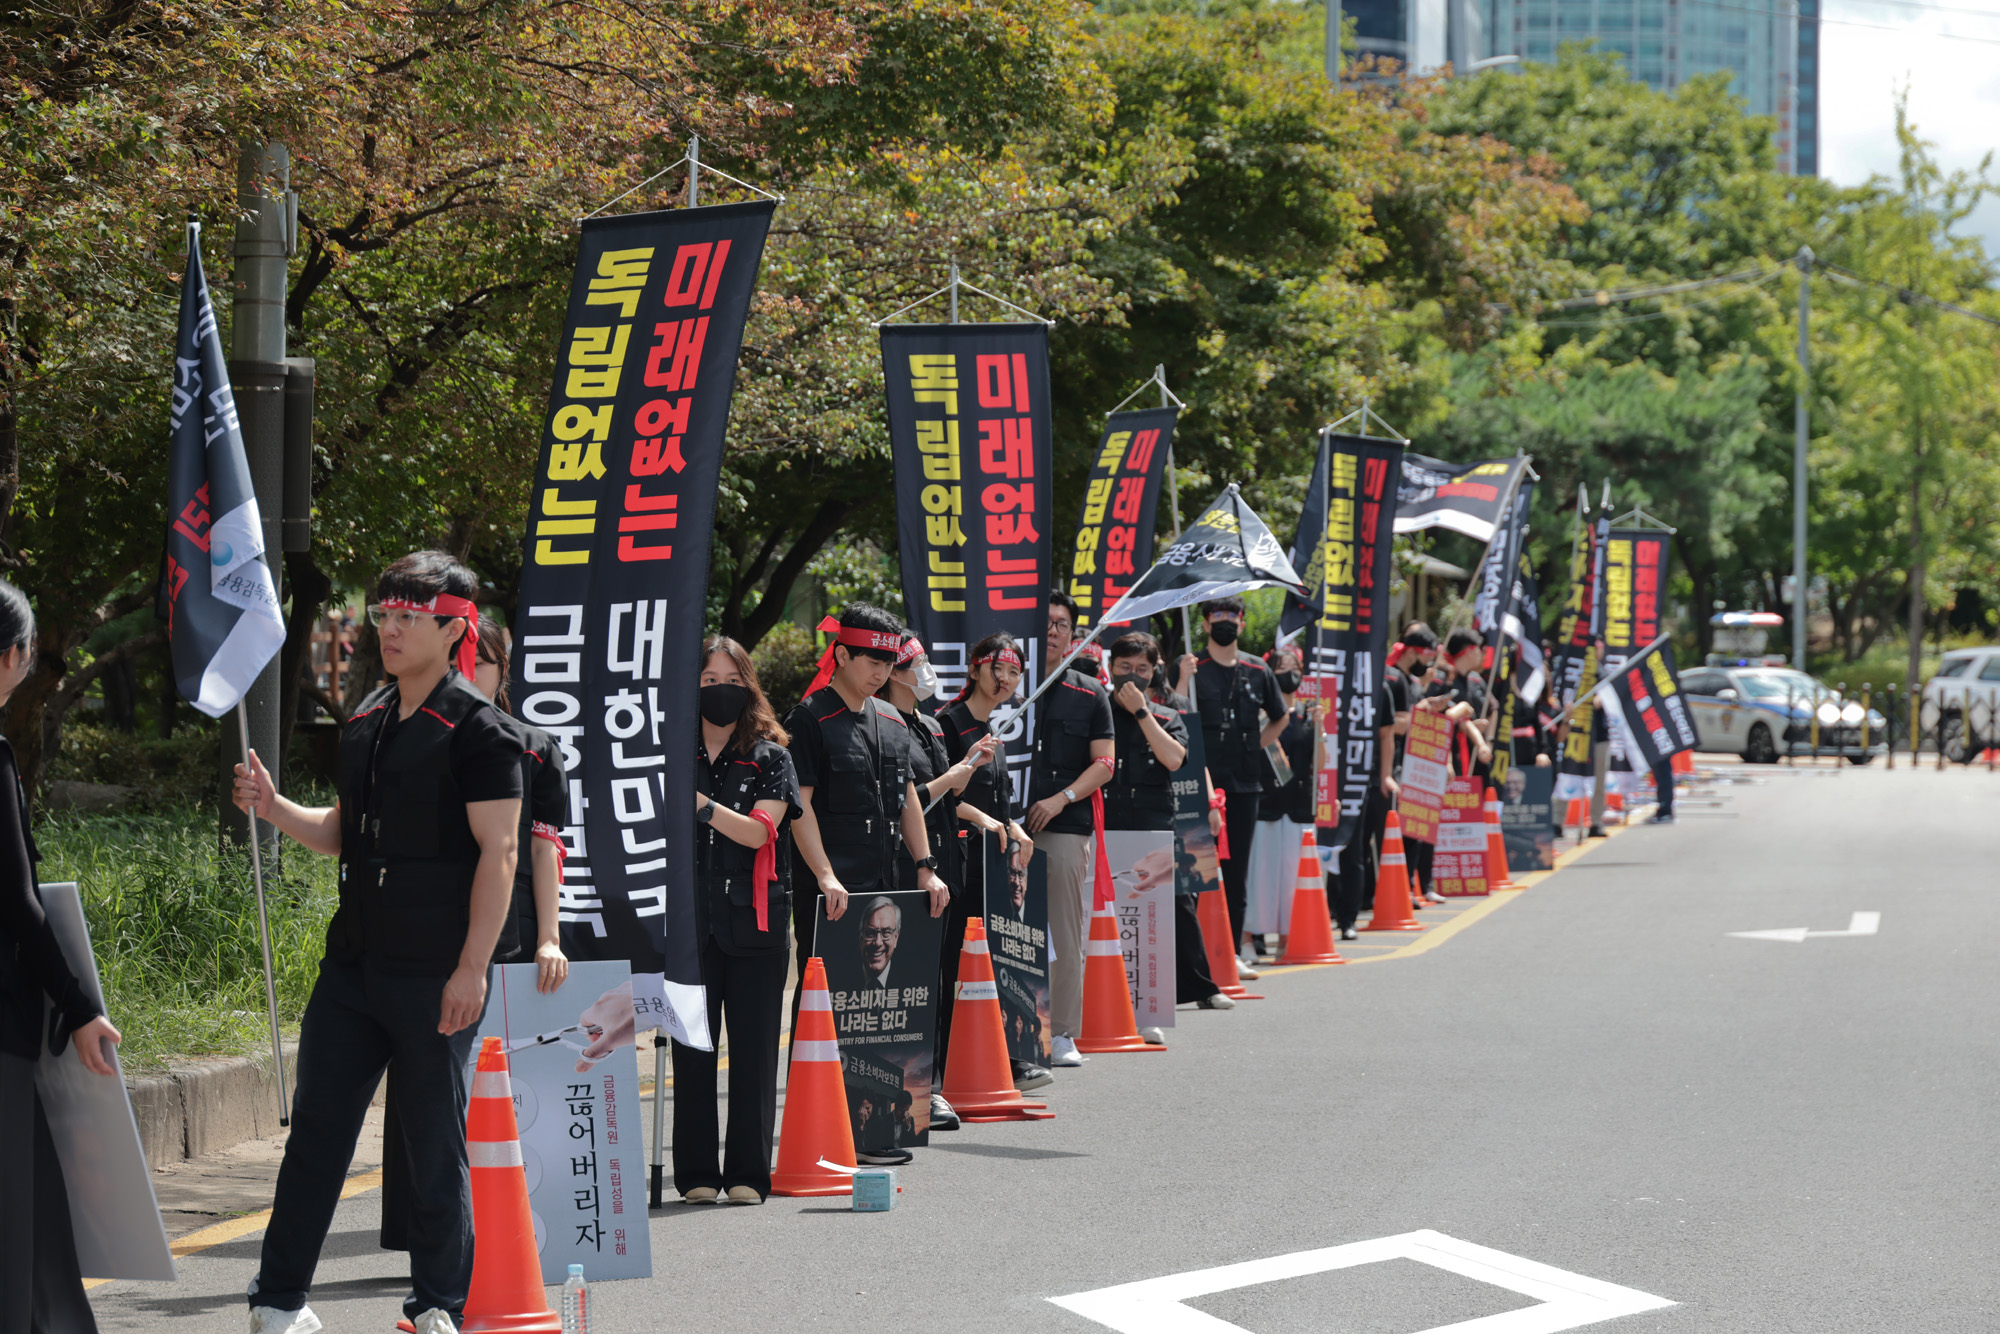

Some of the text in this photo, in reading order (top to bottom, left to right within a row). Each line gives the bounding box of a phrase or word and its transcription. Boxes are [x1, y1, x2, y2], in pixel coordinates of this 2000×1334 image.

[535, 247, 655, 566] 독립없는
[617, 239, 732, 563] 미래없는
[909, 354, 968, 612] 독립없는
[976, 353, 1040, 611] 미래없는
[1069, 430, 1133, 626] 독립없는
[1101, 428, 1161, 628] 미래없는
[1314, 452, 1358, 631] 독립없는
[871, 633, 895, 649] 금소원
[1171, 779, 1199, 796] 위한
[1340, 650, 1377, 816] 대한민국
[902, 986, 929, 1008] 위한
[990, 913, 1045, 948] 금융소비자를 위한
[1001, 936, 1036, 964] 나라는 없다
[840, 1010, 908, 1033] 나라는 없다
[850, 1056, 900, 1089] 금융소비자보호원
[854, 1036, 866, 1045] FOR
[866, 1034, 893, 1044] FINANCIAL
[893, 1032, 924, 1043] CONSUMERS
[564, 1083, 606, 1253] 끊어버리자
[602, 1075, 627, 1256] 금융감독원 독립성을 위해
